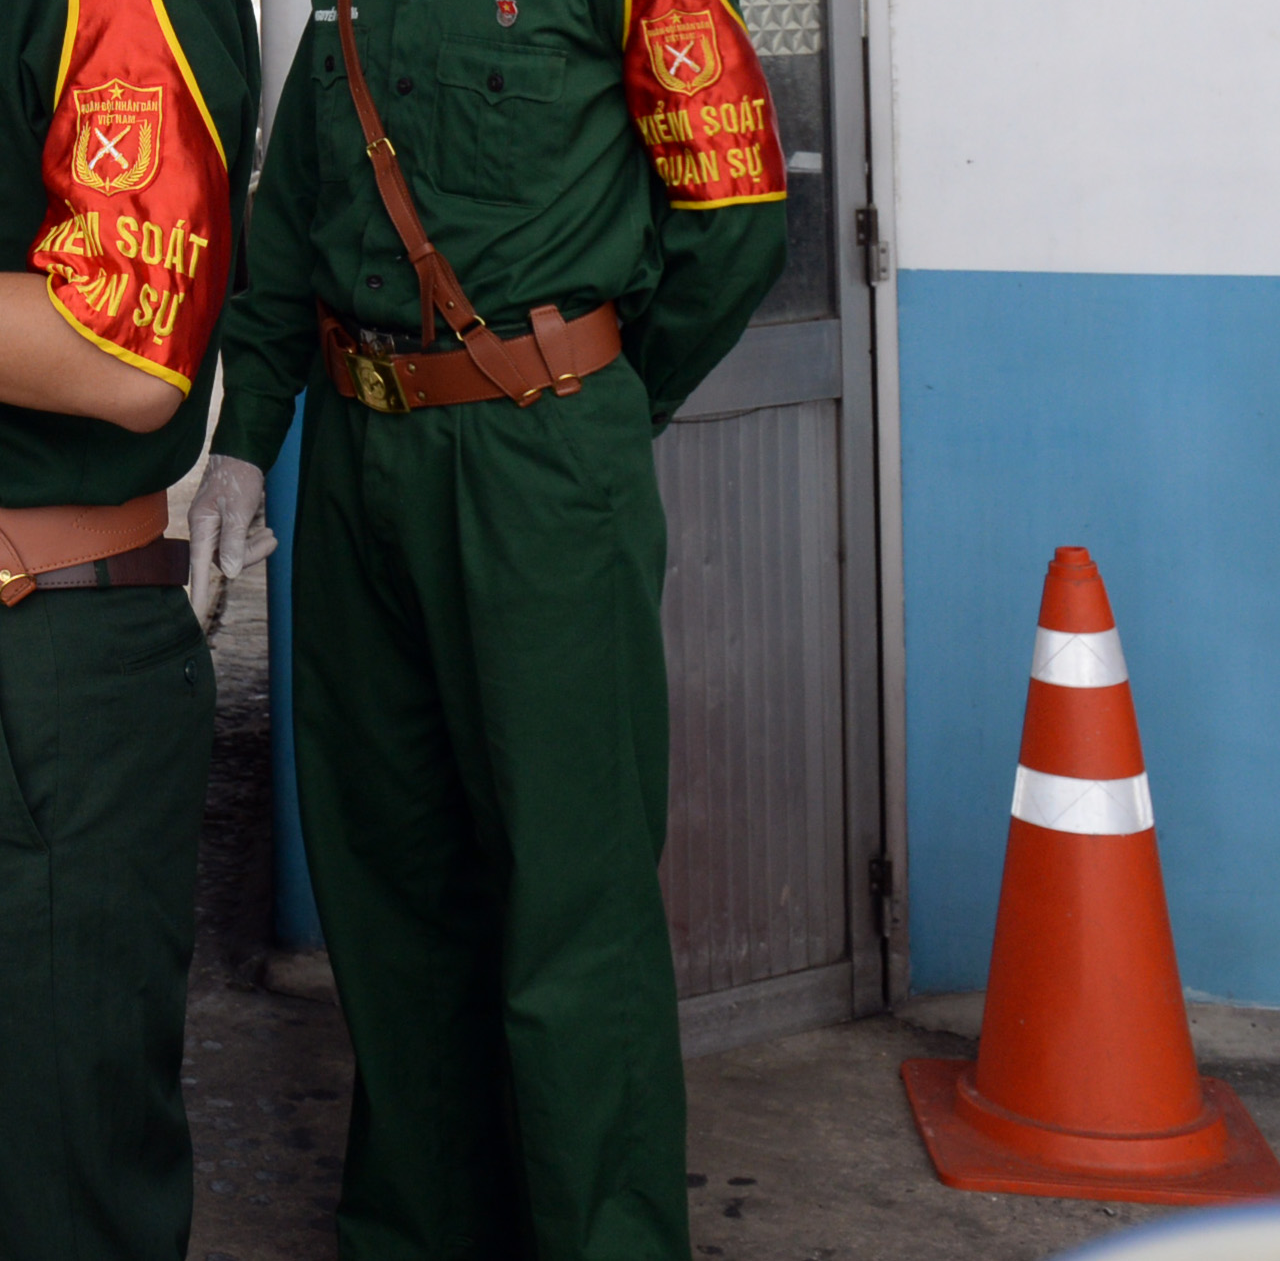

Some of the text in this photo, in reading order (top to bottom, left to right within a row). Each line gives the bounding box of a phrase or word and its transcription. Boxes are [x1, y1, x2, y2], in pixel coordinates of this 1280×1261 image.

[115, 114, 136, 125] NAM
[701, 95, 765, 136] SOÁT
[727, 143, 763, 183] SỰ
[116, 216, 208, 278] SOÁT
[133, 283, 185, 345] SỰ
